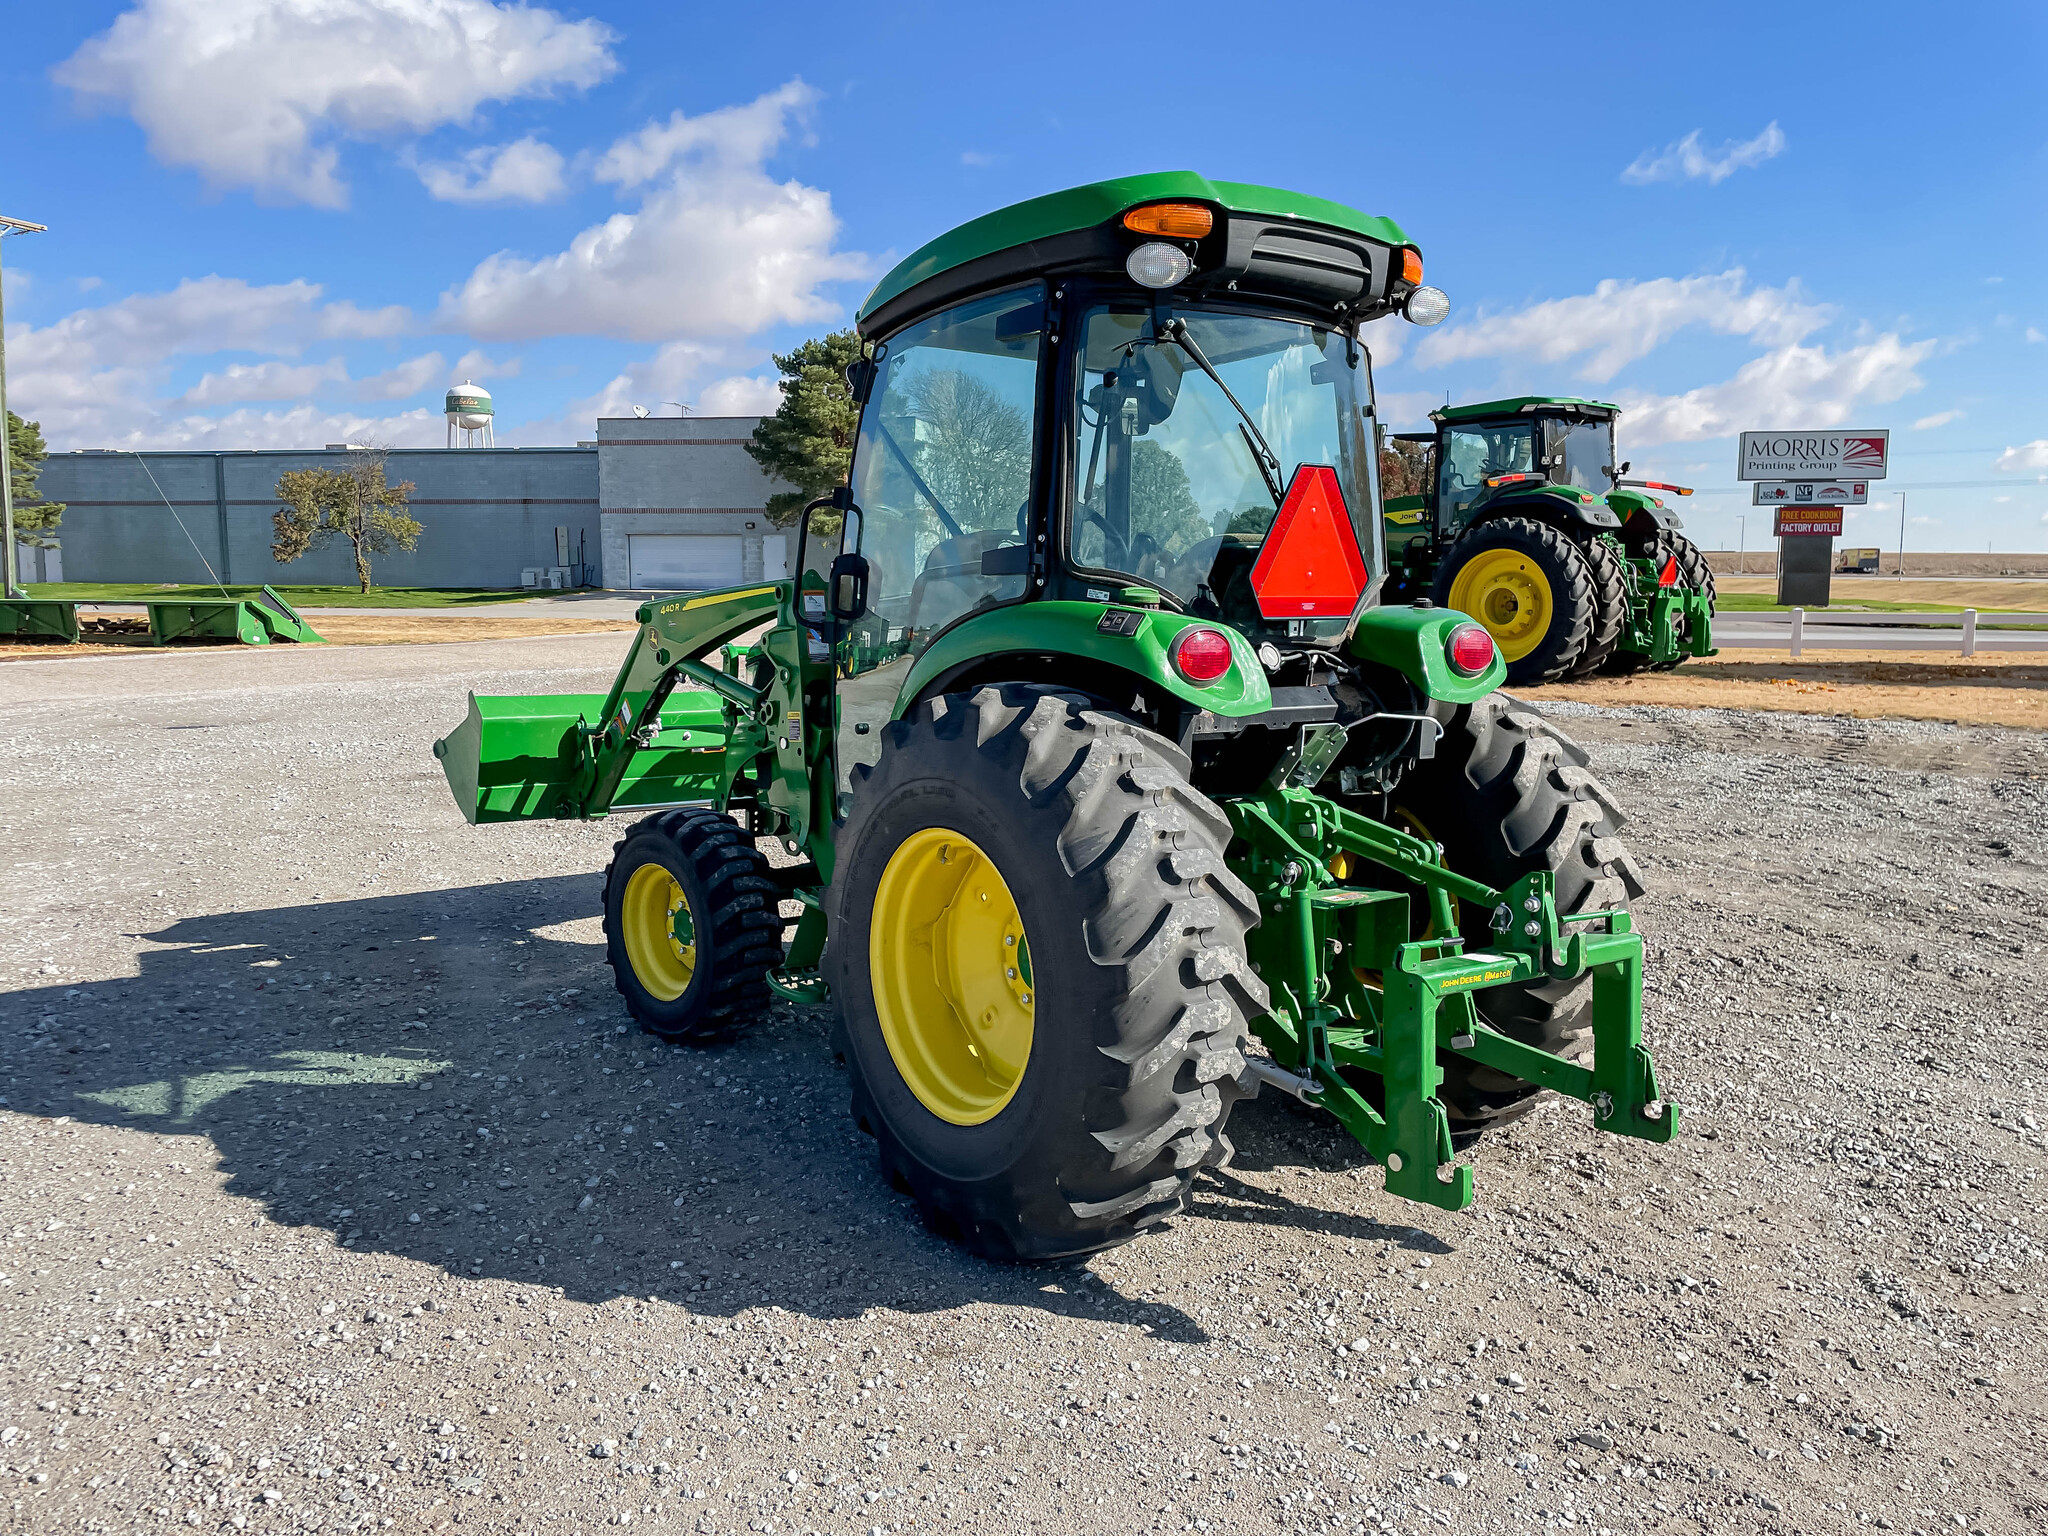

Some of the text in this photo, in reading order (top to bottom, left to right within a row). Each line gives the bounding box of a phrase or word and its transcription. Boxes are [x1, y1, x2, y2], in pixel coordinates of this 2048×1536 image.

[1750, 438, 1840, 460] MORRIS
[1749, 461, 1837, 471] Printing Group
[1781, 510, 1841, 520] FREE COOKBOOK!
[1780, 523, 1840, 532] FACTORY OUTLET
[1441, 979, 1459, 988] JOHN
[1460, 975, 1482, 985] DEERE
